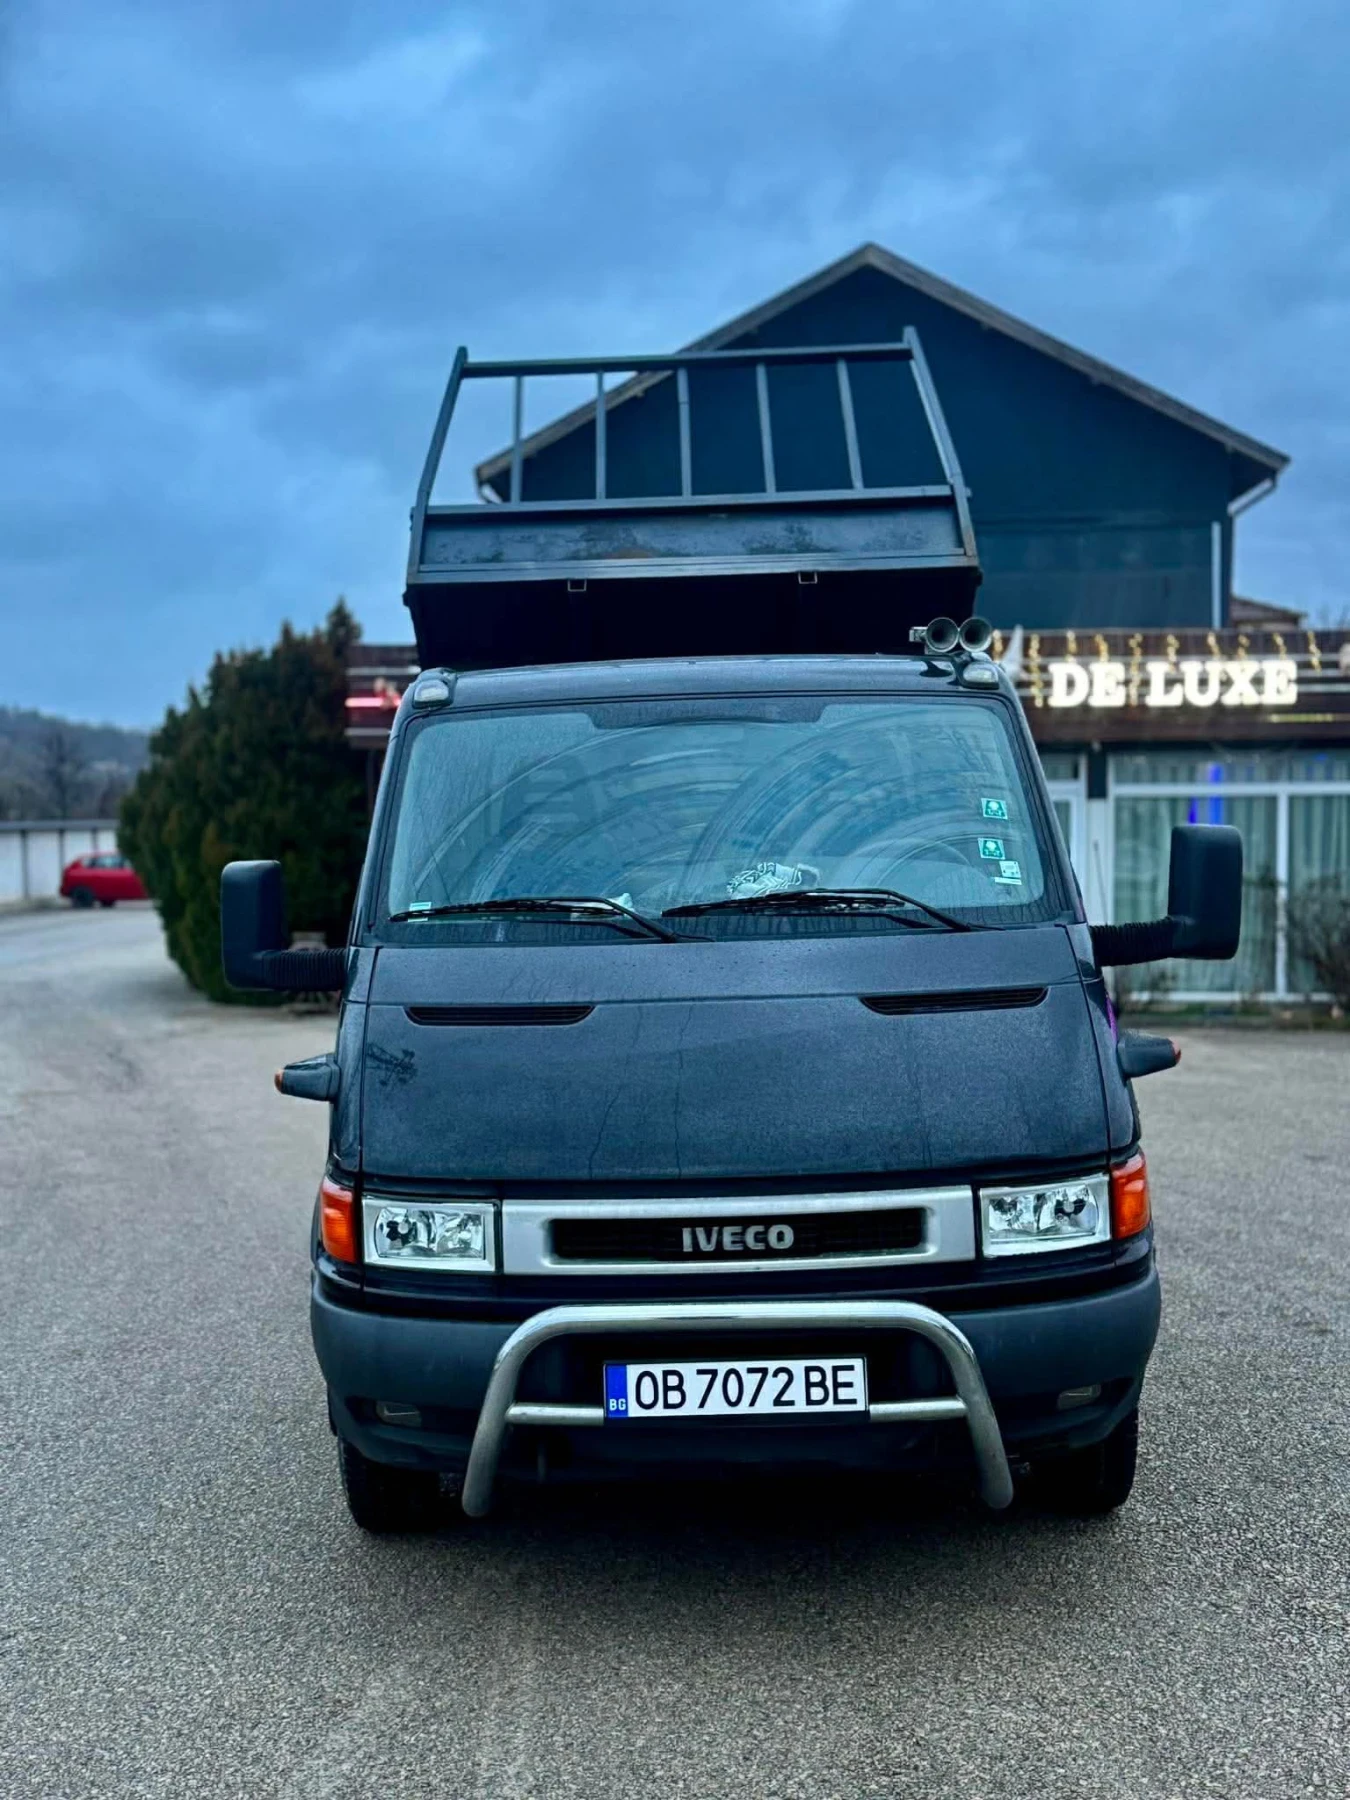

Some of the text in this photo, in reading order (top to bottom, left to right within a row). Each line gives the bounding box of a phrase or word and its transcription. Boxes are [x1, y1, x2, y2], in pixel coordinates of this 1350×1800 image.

[1048, 659, 1298, 707] DE LUXE
[682, 1224, 794, 1252] IVECO
[609, 1398, 626, 1411] BG
